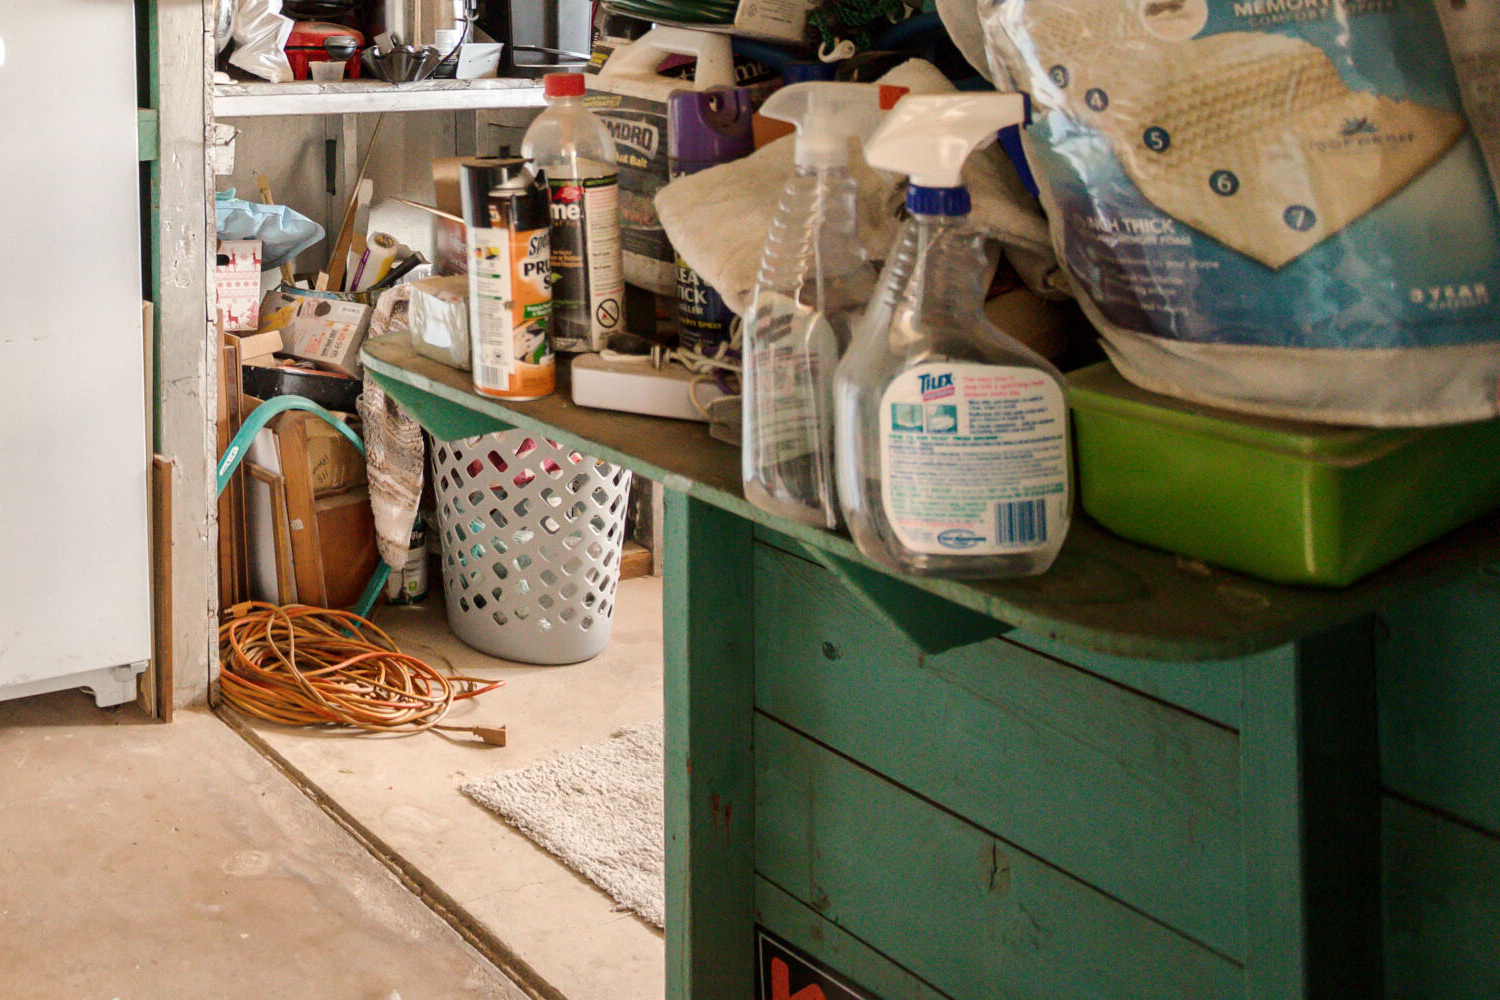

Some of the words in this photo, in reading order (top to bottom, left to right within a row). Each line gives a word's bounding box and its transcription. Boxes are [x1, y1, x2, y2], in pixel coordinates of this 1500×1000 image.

[1151, 131, 1163, 149] 5
[1217, 173, 1231, 193] 6
[917, 372, 955, 395] TILEX
